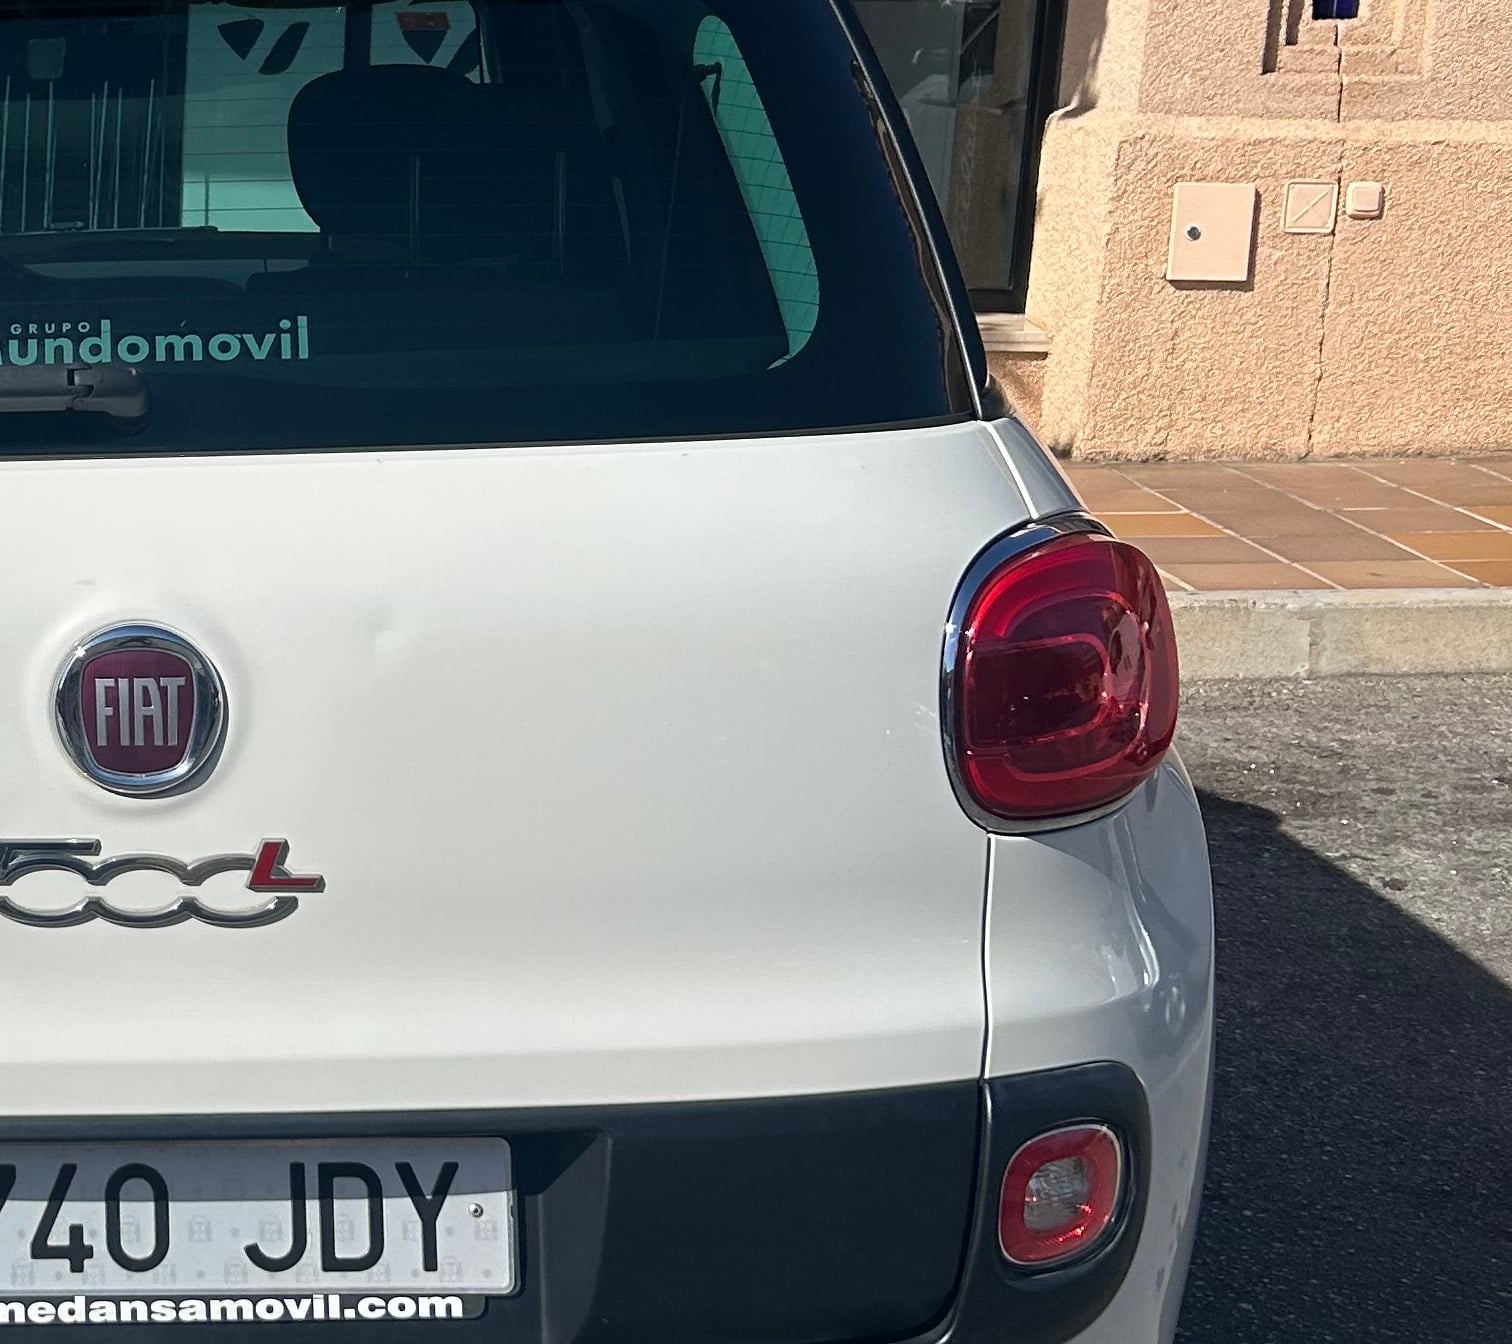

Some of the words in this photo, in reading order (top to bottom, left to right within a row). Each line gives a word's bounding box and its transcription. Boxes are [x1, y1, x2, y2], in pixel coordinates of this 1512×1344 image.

[10, 321, 91, 336] GRUPO
[94, 676, 187, 747] FIAT
[243, 1160, 460, 1273] JDY
